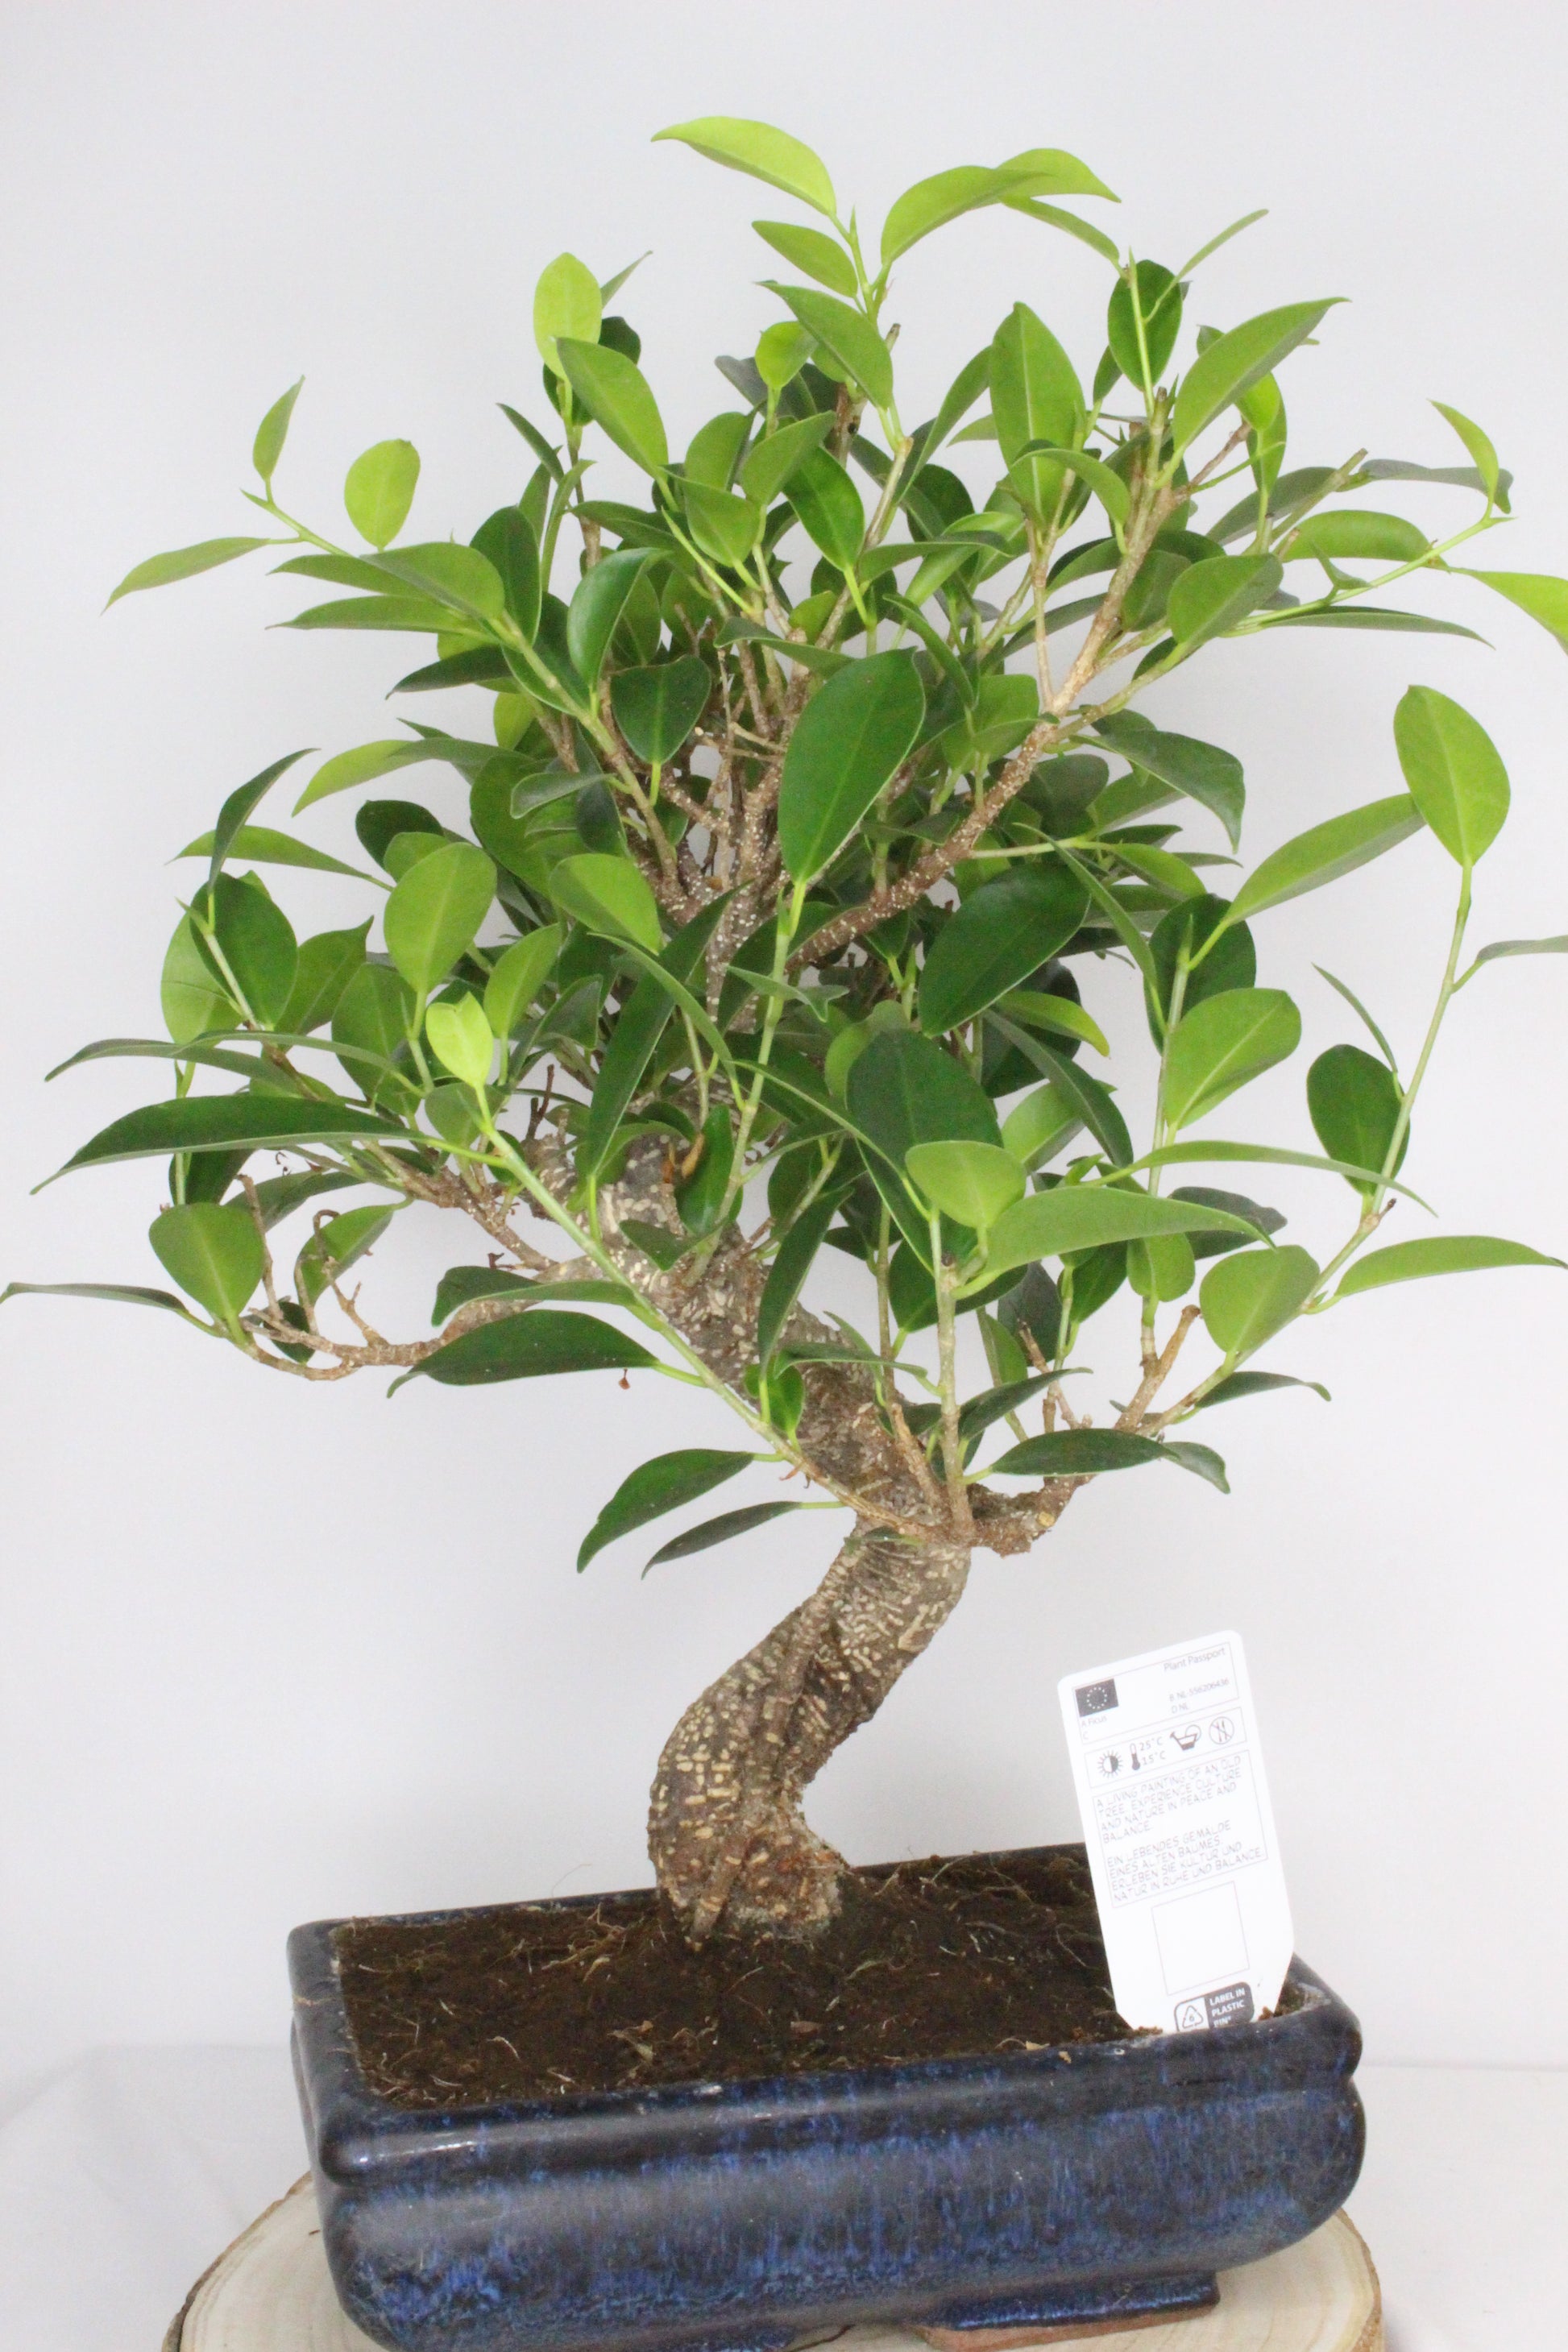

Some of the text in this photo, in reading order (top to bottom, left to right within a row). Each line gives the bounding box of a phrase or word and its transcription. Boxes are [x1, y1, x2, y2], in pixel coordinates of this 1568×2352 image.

[1164, 1647, 1226, 1672] Plant Passport
[1088, 1715, 1107, 1726] Ficus
[1097, 1755, 1242, 1808] A LIVING PAINTING OF AN OLD
[1131, 1782, 1192, 1811] EXPERIENCE
[1196, 1768, 1241, 1790] CULTURE
[1101, 1782, 1237, 1831] AND NATURE IN PEACE AND
[1107, 1854, 1123, 1867] EIN
[1126, 1836, 1180, 1861] LEBENDES
[1110, 1861, 1139, 1879] EINES
[1143, 1850, 1175, 1869] ALTEN
[1112, 1841, 1242, 1890] ERLEBEN SIE KULTUR UND
[1114, 1884, 1147, 1902] NATUR
[1151, 1880, 1159, 1891] IN
[1163, 1871, 1188, 1887] RUHE
[1192, 1863, 1213, 1877] UND
[1209, 1988, 1245, 2006] LABEL IN
[1212, 2000, 1245, 2017] PLASTIC
